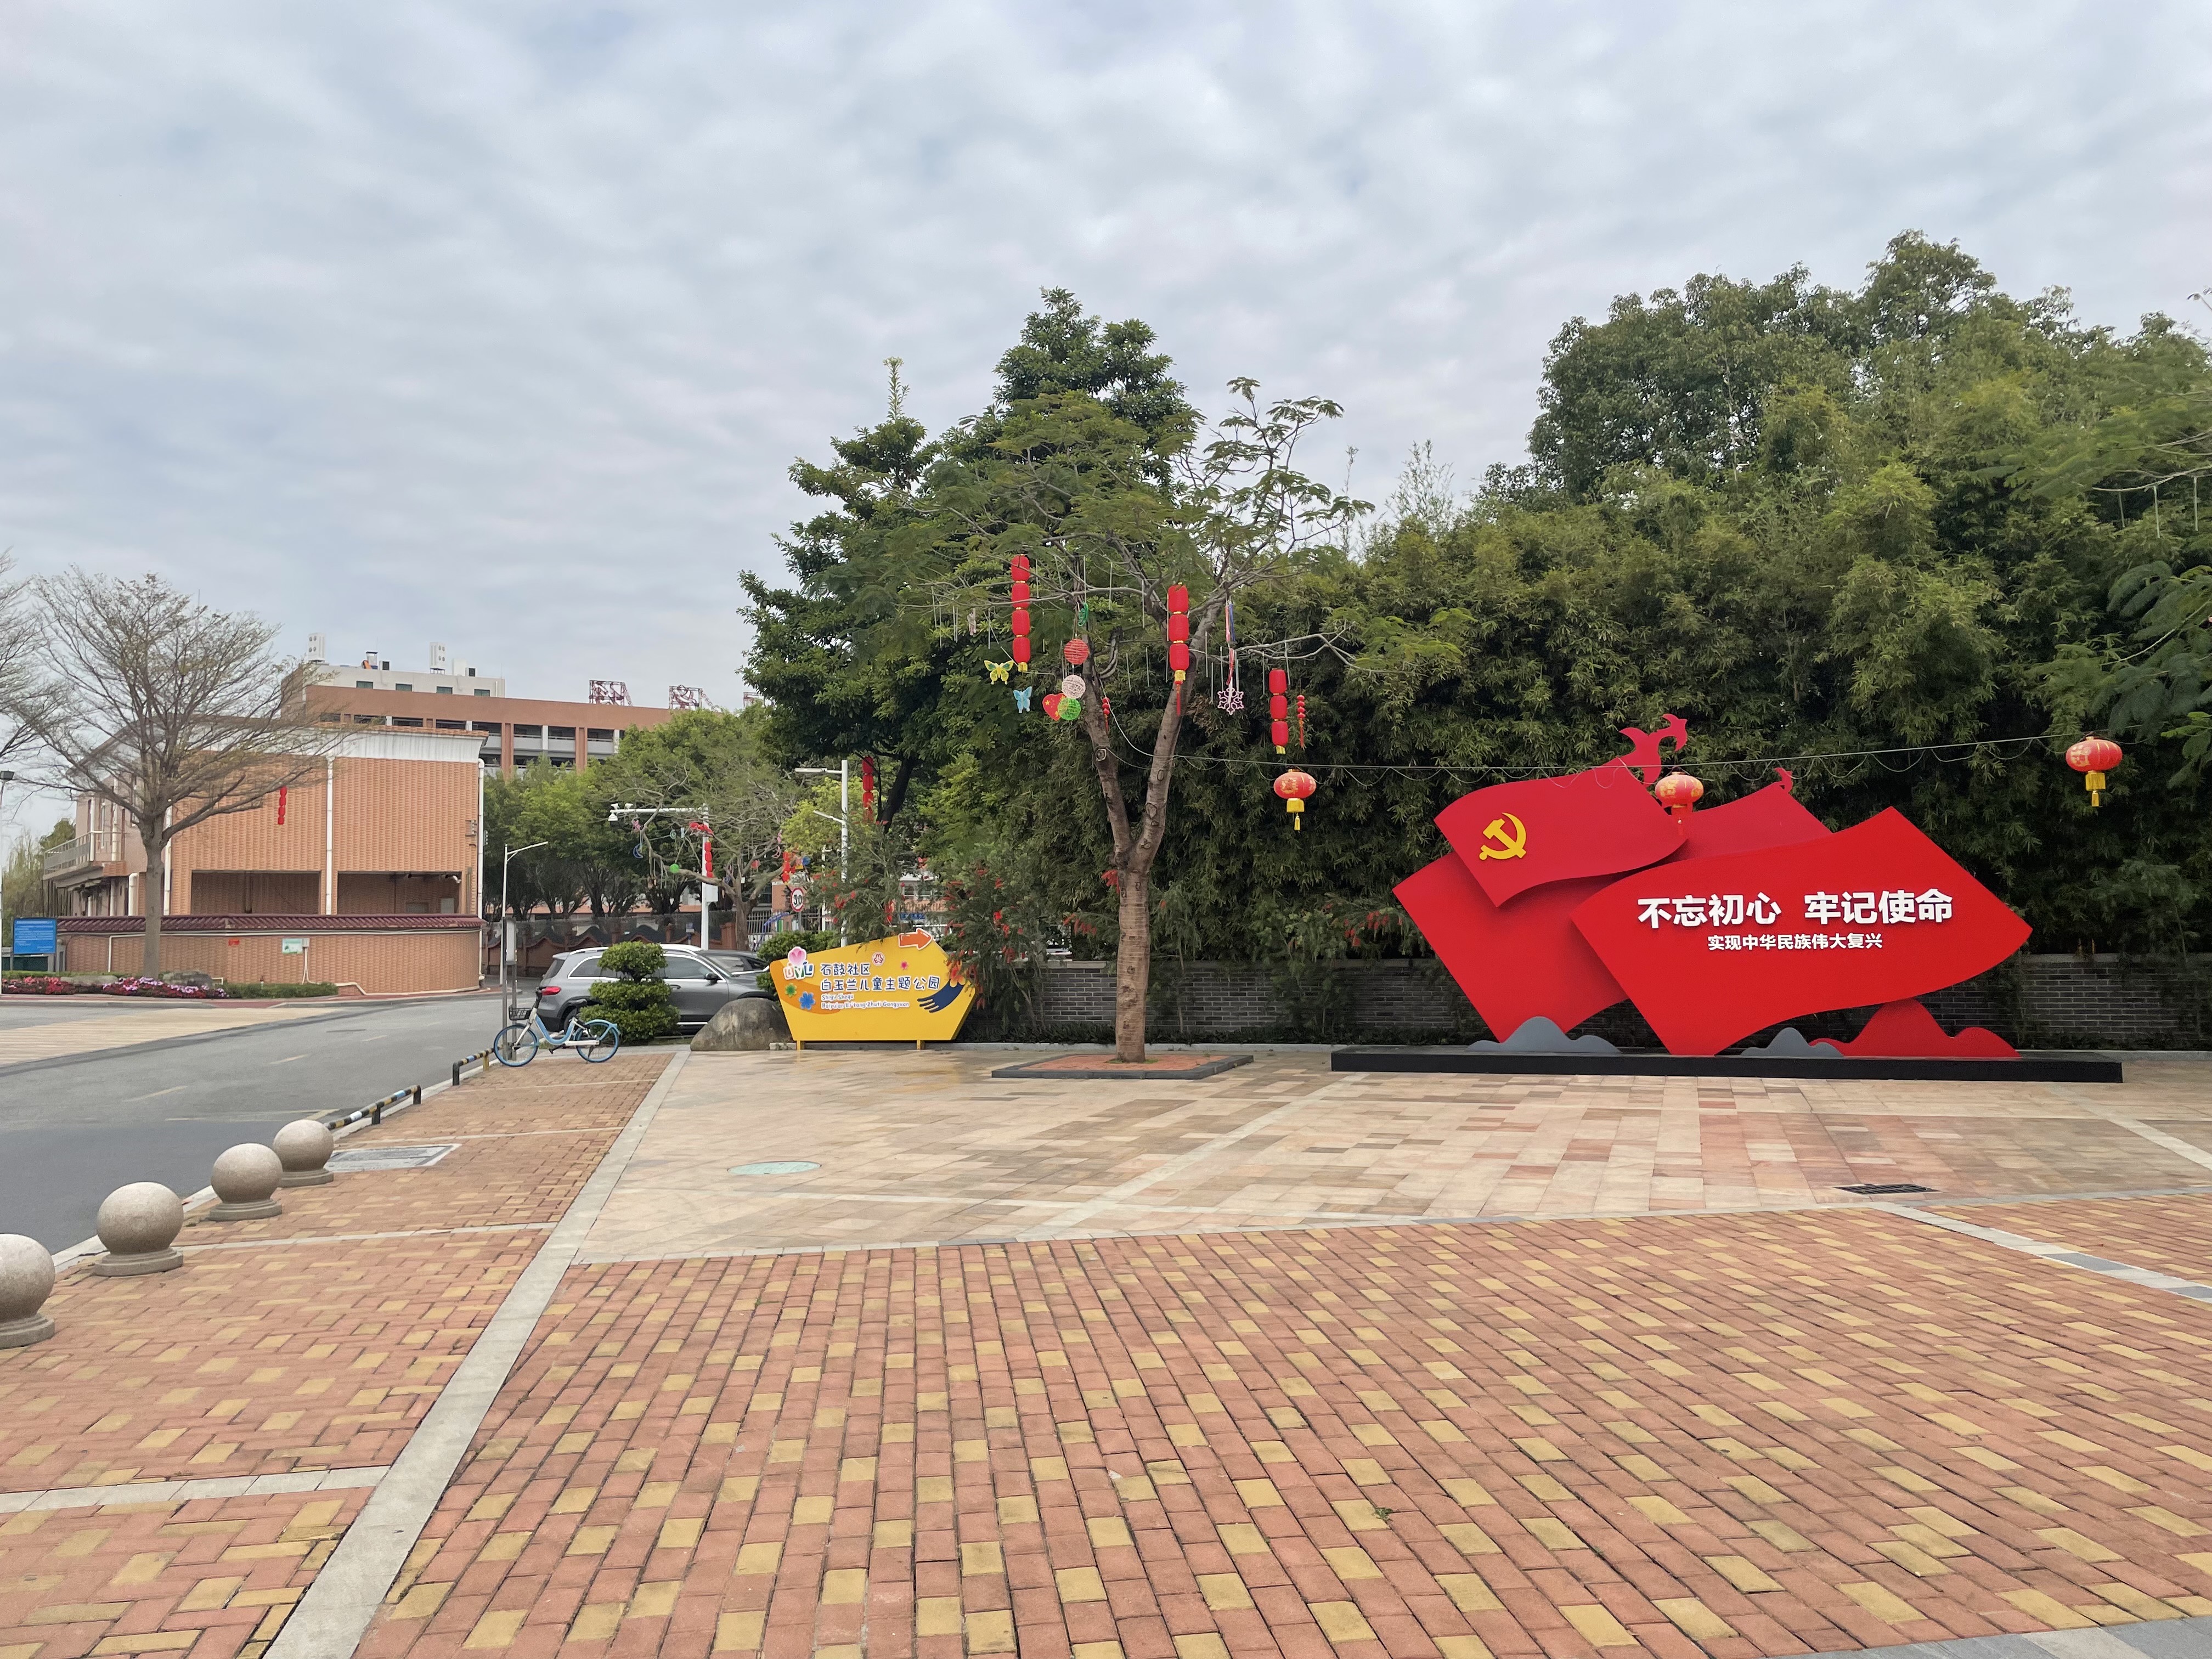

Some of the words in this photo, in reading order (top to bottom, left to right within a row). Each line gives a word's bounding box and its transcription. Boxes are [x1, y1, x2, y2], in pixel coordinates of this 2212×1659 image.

[793, 894, 803, 905] 30
[1637, 891, 1782, 929] 不忘初心
[1804, 888, 1953, 925] 牢记使命
[1707, 932, 1883, 951] 实现中华民族伟大复兴
[821, 963, 870, 975] 石鼓社区
[821, 977, 940, 991] 白玉兰儿童主题公园
